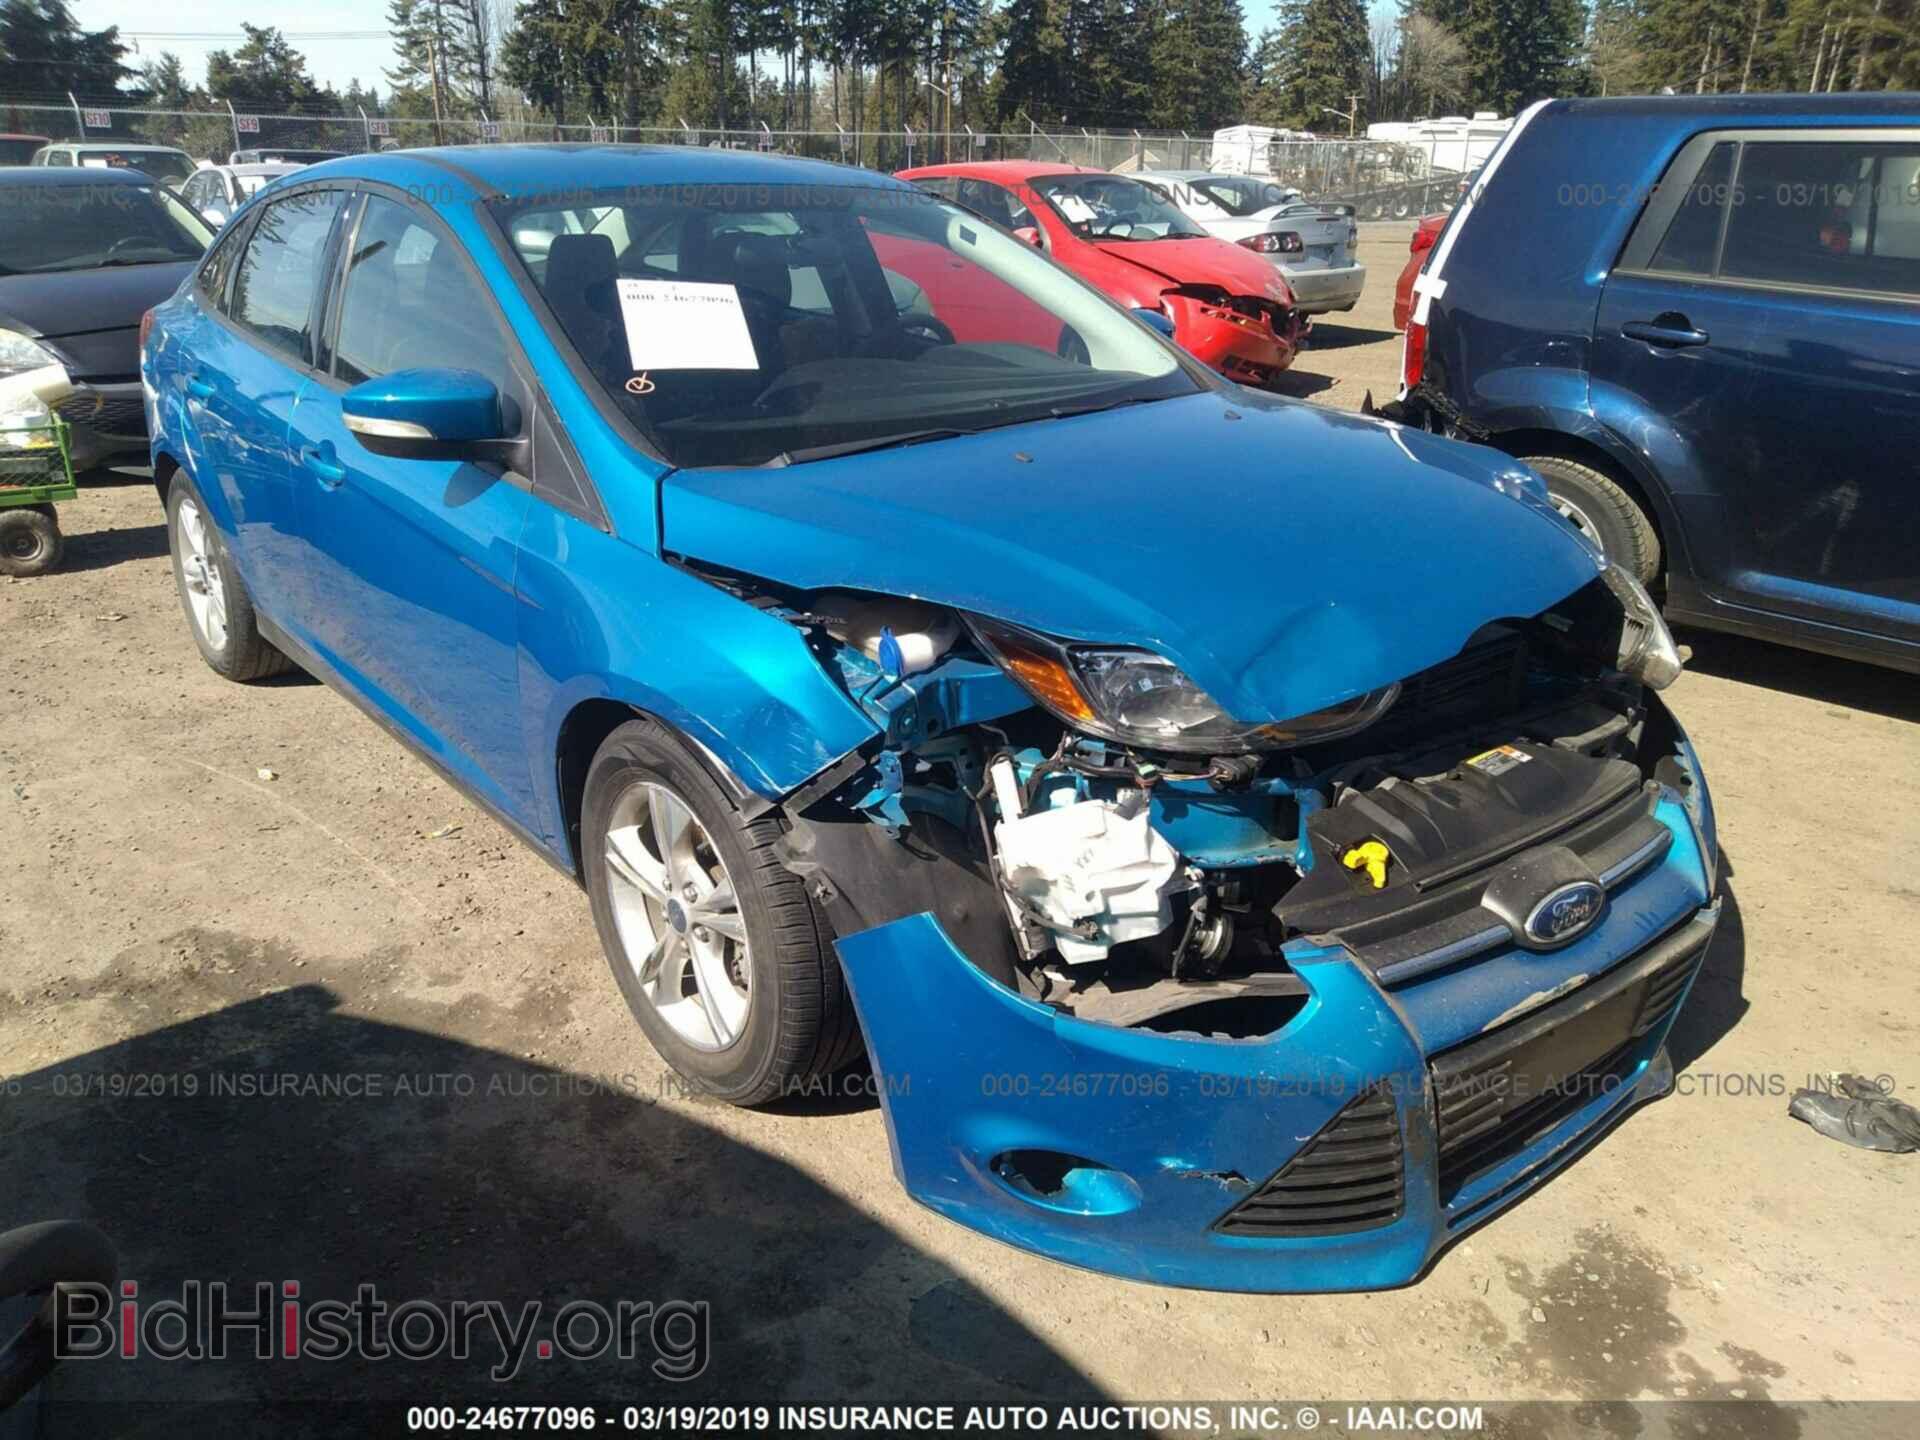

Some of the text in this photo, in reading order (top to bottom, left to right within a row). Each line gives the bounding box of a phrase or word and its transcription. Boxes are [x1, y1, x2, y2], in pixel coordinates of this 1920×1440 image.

[86, 113, 110, 126] SF10
[239, 118, 257, 130] SF9
[1552, 894, 1591, 934] Ford
